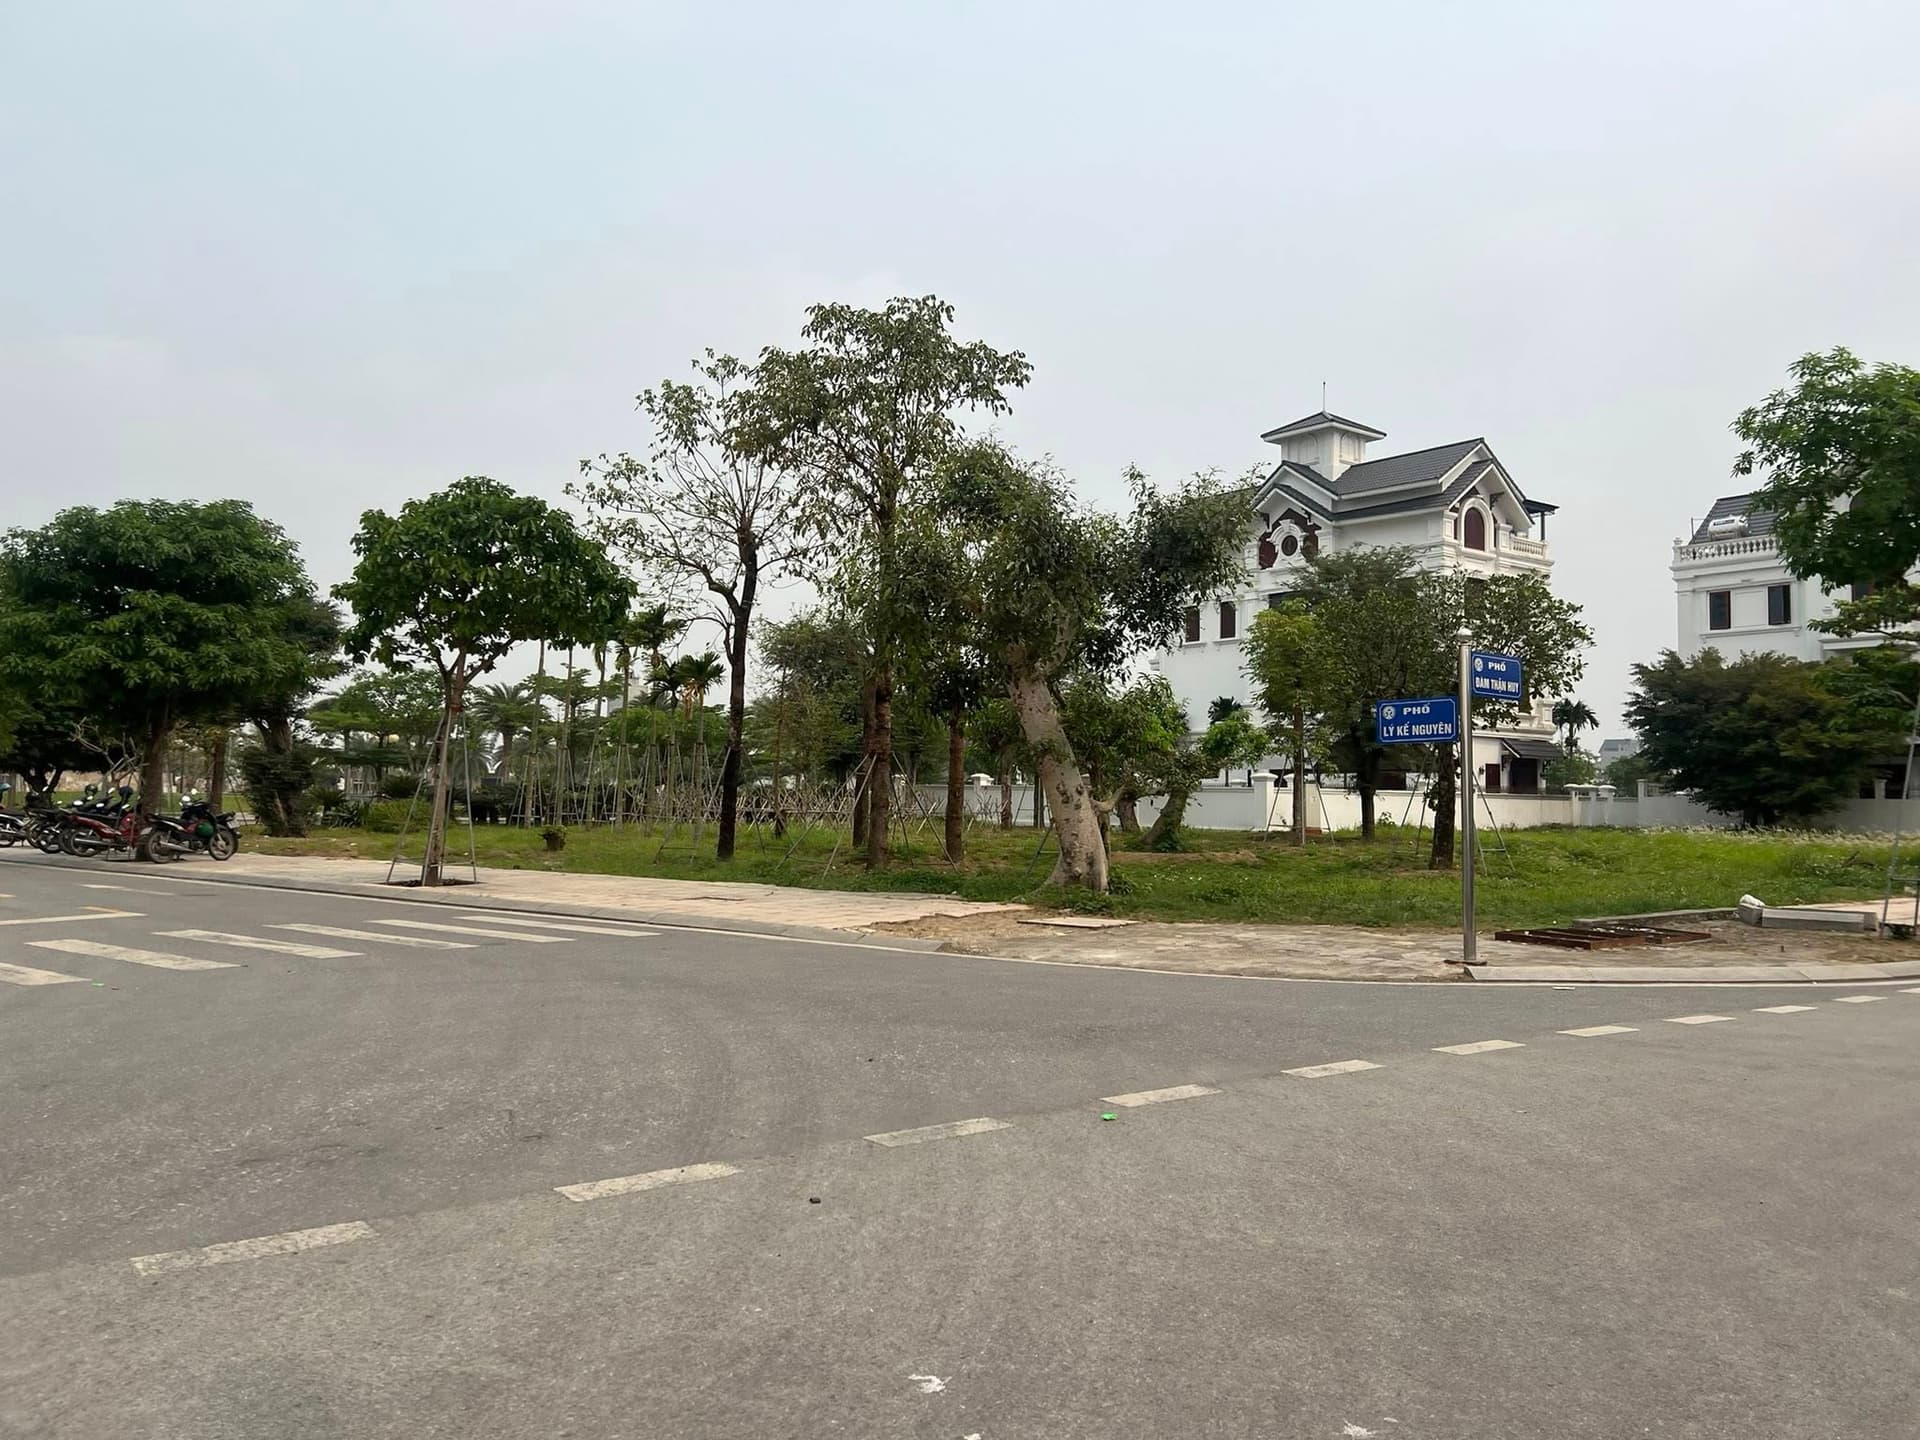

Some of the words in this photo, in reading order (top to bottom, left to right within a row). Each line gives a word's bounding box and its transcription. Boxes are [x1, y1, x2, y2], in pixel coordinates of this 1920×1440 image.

[1488, 661, 1506, 672] PHỐ
[1507, 681, 1519, 694] HUY
[1402, 702, 1431, 715] PHỐ
[1383, 723, 1395, 737] LÝ
[1396, 721, 1410, 737] KẾ
[1411, 721, 1452, 736] NGUYÊN
